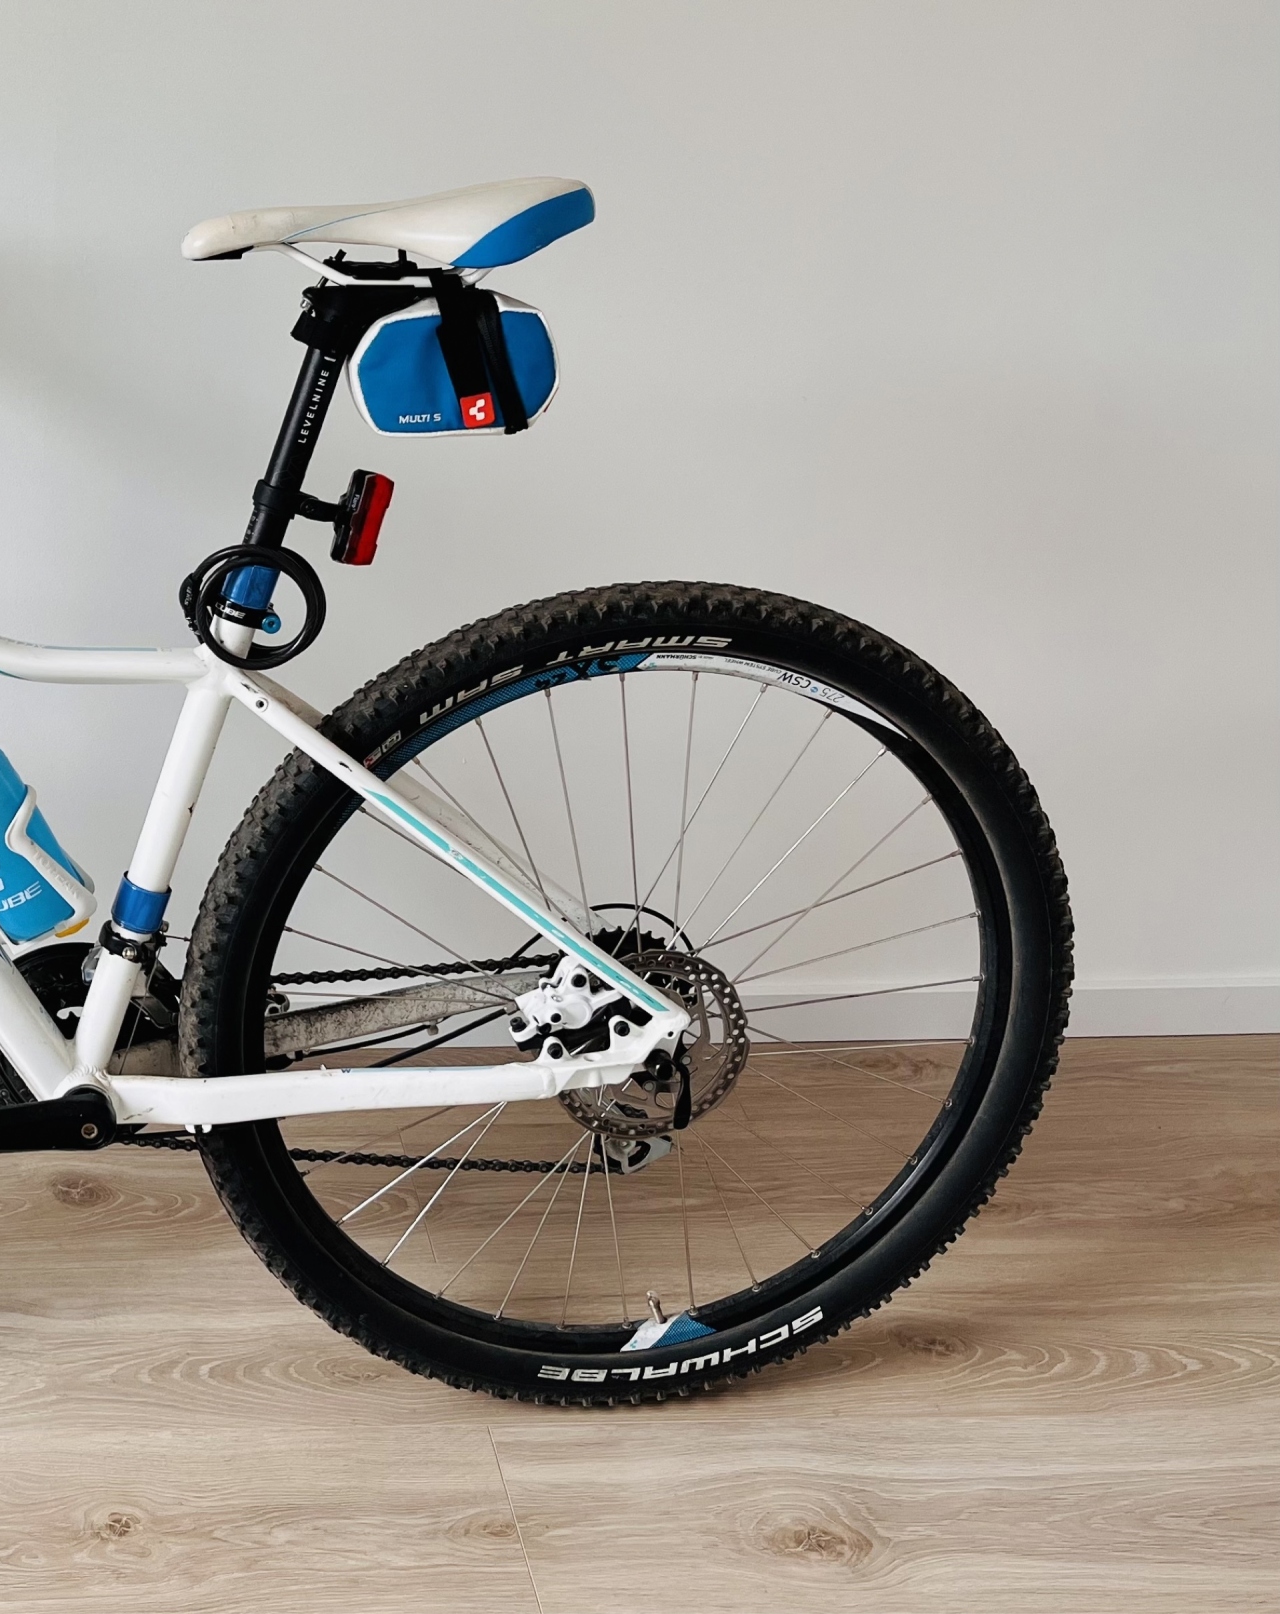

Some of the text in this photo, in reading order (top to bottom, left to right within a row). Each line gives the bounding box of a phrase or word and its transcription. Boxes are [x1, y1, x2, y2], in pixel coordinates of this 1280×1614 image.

[297, 369, 330, 444] LEVELNINE
[398, 412, 442, 425] MULTI S
[419, 635, 733, 725] SMART SAM
[778, 671, 812, 689] CSW
[537, 1305, 824, 1383] SCHWALBE
